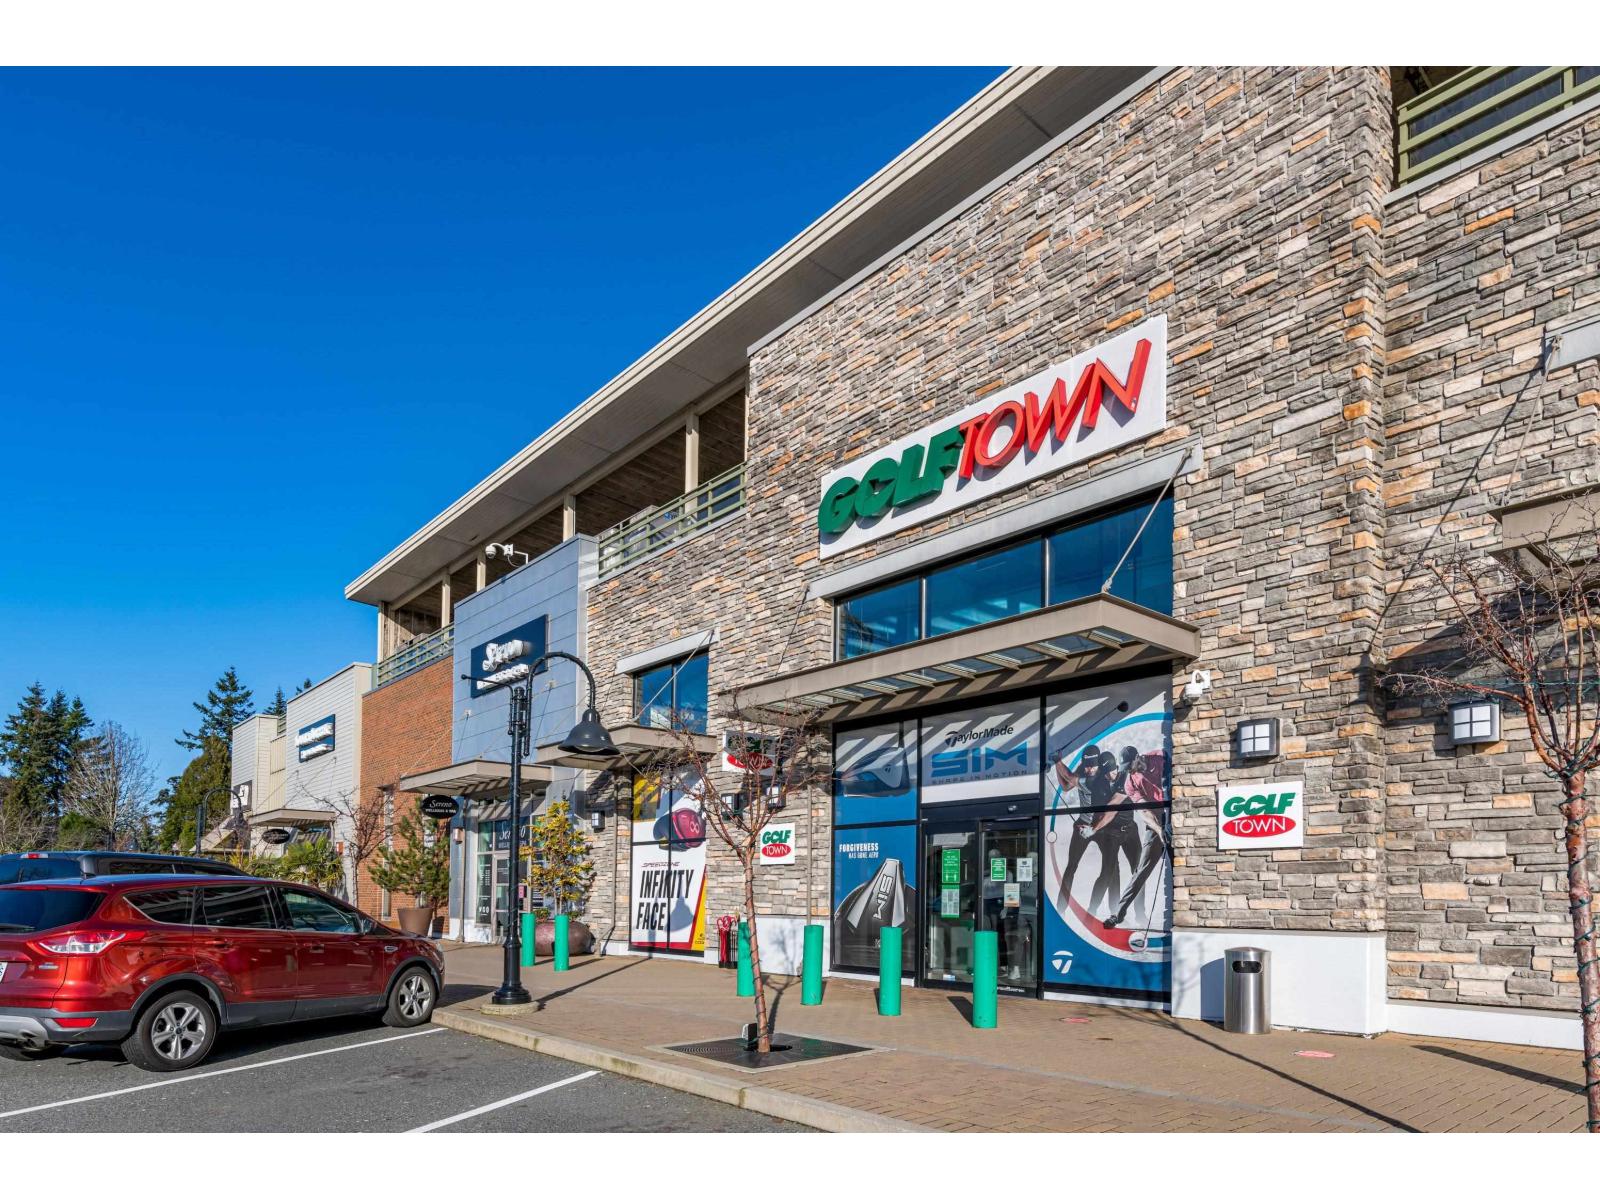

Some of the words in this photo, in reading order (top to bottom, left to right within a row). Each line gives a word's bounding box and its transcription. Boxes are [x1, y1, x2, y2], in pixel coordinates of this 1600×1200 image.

[818, 427, 965, 534] GOLF
[959, 338, 1152, 480] TOWN
[945, 725, 1014, 747] TaylorMade
[931, 740, 1028, 778] SIM
[985, 770, 1028, 779] MOTION
[1222, 792, 1296, 817] GOLF
[1232, 817, 1286, 834] TOWN
[762, 830, 792, 845] GOLF
[765, 845, 788, 856] TOWN
[839, 842, 879, 853] FORGIVENESS
[636, 902, 667, 931] FACE
